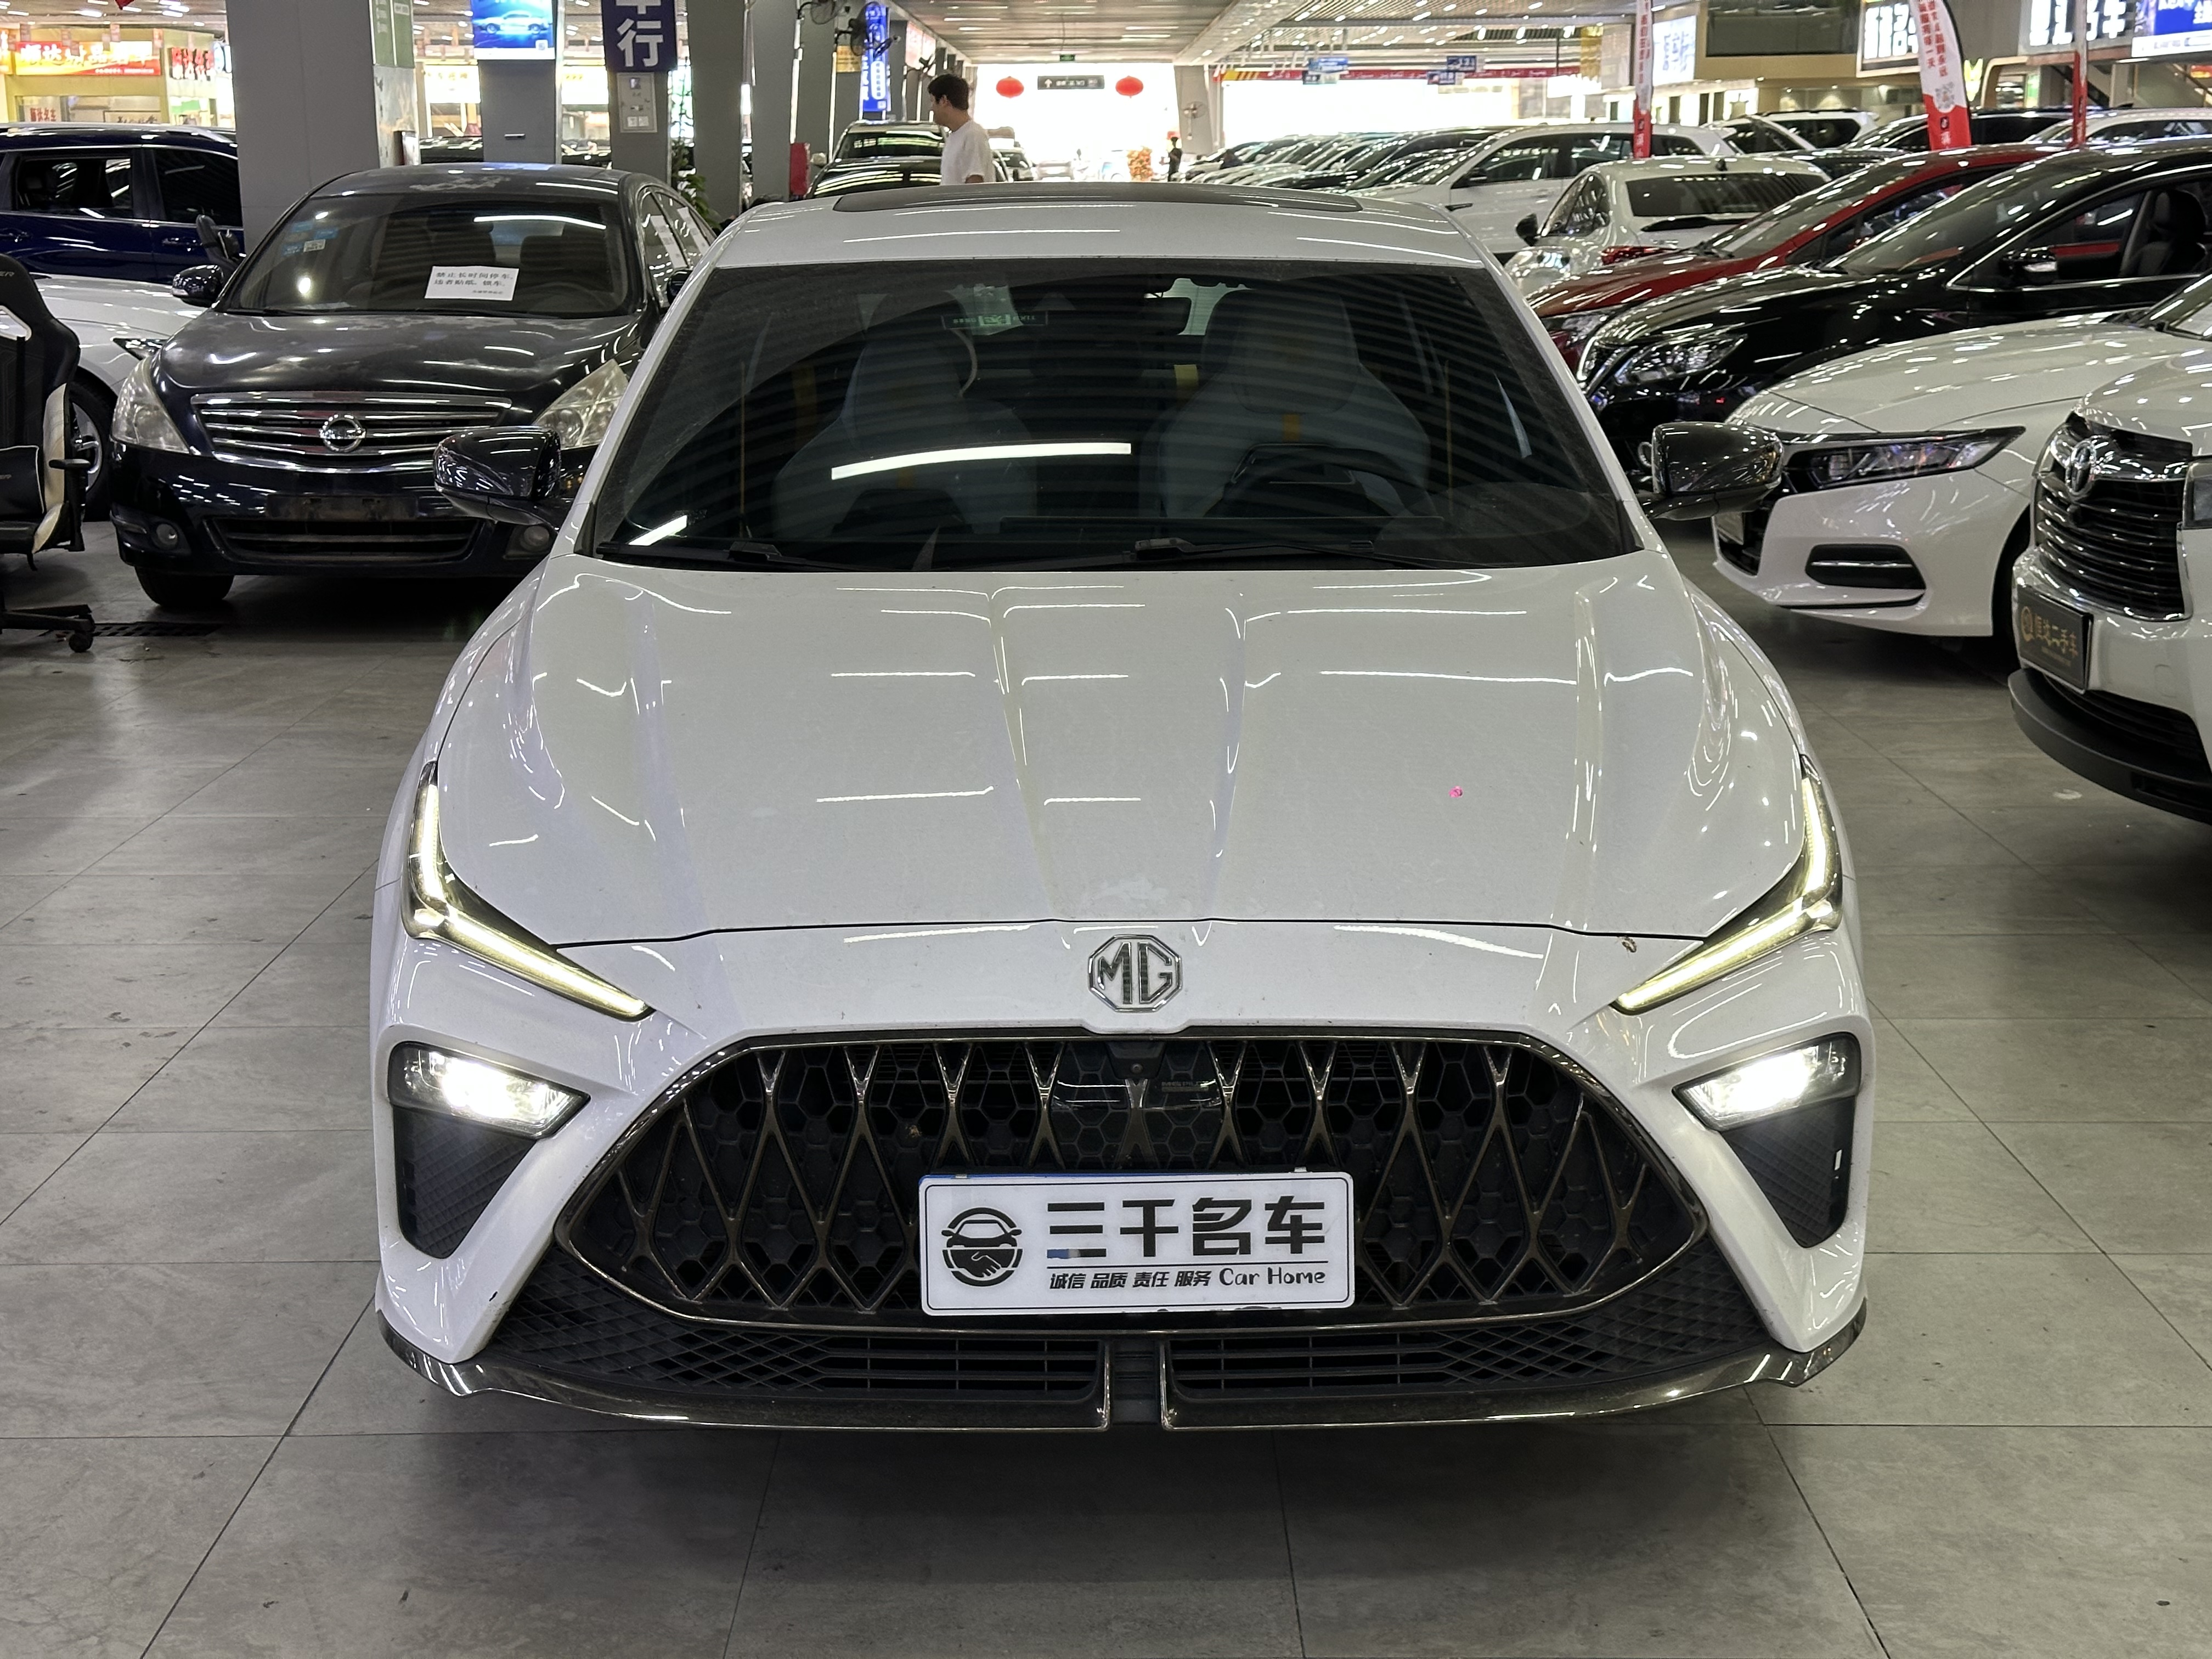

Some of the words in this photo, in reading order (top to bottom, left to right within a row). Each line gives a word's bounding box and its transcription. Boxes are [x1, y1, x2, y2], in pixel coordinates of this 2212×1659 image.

[1098, 942, 1173, 1005] MG
[1047, 1196, 1325, 1259] 三千名车
[1049, 1273, 1086, 1289] 诚信
[1091, 1272, 1128, 1289] 品质
[1132, 1271, 1170, 1288] 责任
[1175, 1271, 1211, 1287] 服务
[1220, 1268, 1260, 1286] Car
[1267, 1267, 1325, 1285] Home
